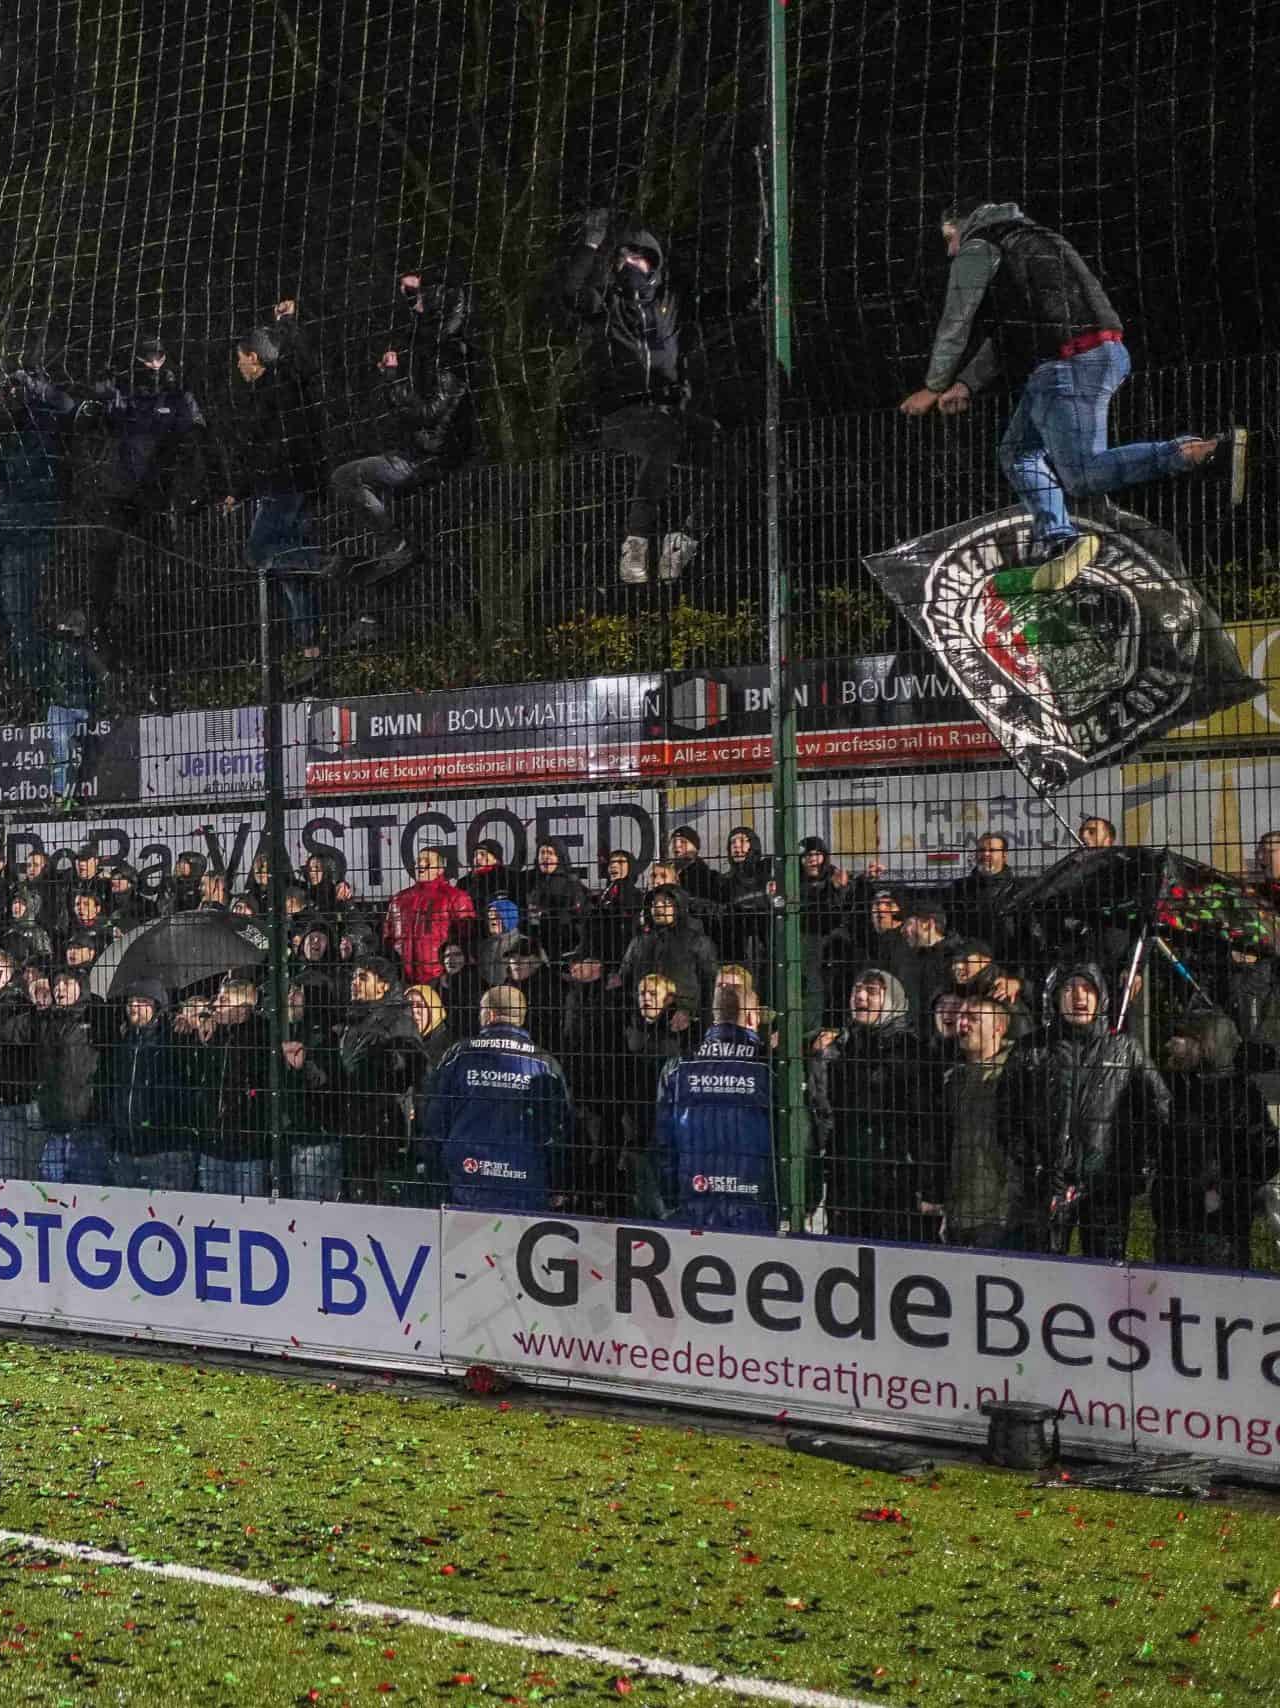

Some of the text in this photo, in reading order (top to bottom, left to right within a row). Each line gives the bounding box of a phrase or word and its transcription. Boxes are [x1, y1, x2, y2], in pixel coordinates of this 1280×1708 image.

[842, 673, 959, 705] BOUWM
[370, 712, 422, 737] BMN
[674, 747, 708, 763] Alles
[713, 745, 746, 761] voor
[928, 733, 944, 747] in
[179, 751, 265, 778] Jellema
[312, 767, 340, 783] Alles
[343, 766, 371, 781] voor
[374, 763, 390, 779] de
[697, 1041, 755, 1057] STEWARD
[701, 1074, 755, 1088] KOMPAS
[516, 1220, 580, 1307] G
[321, 1236, 431, 1322] BV
[517, 1331, 1280, 1457] www.reedebestratingen.nl Amerong
